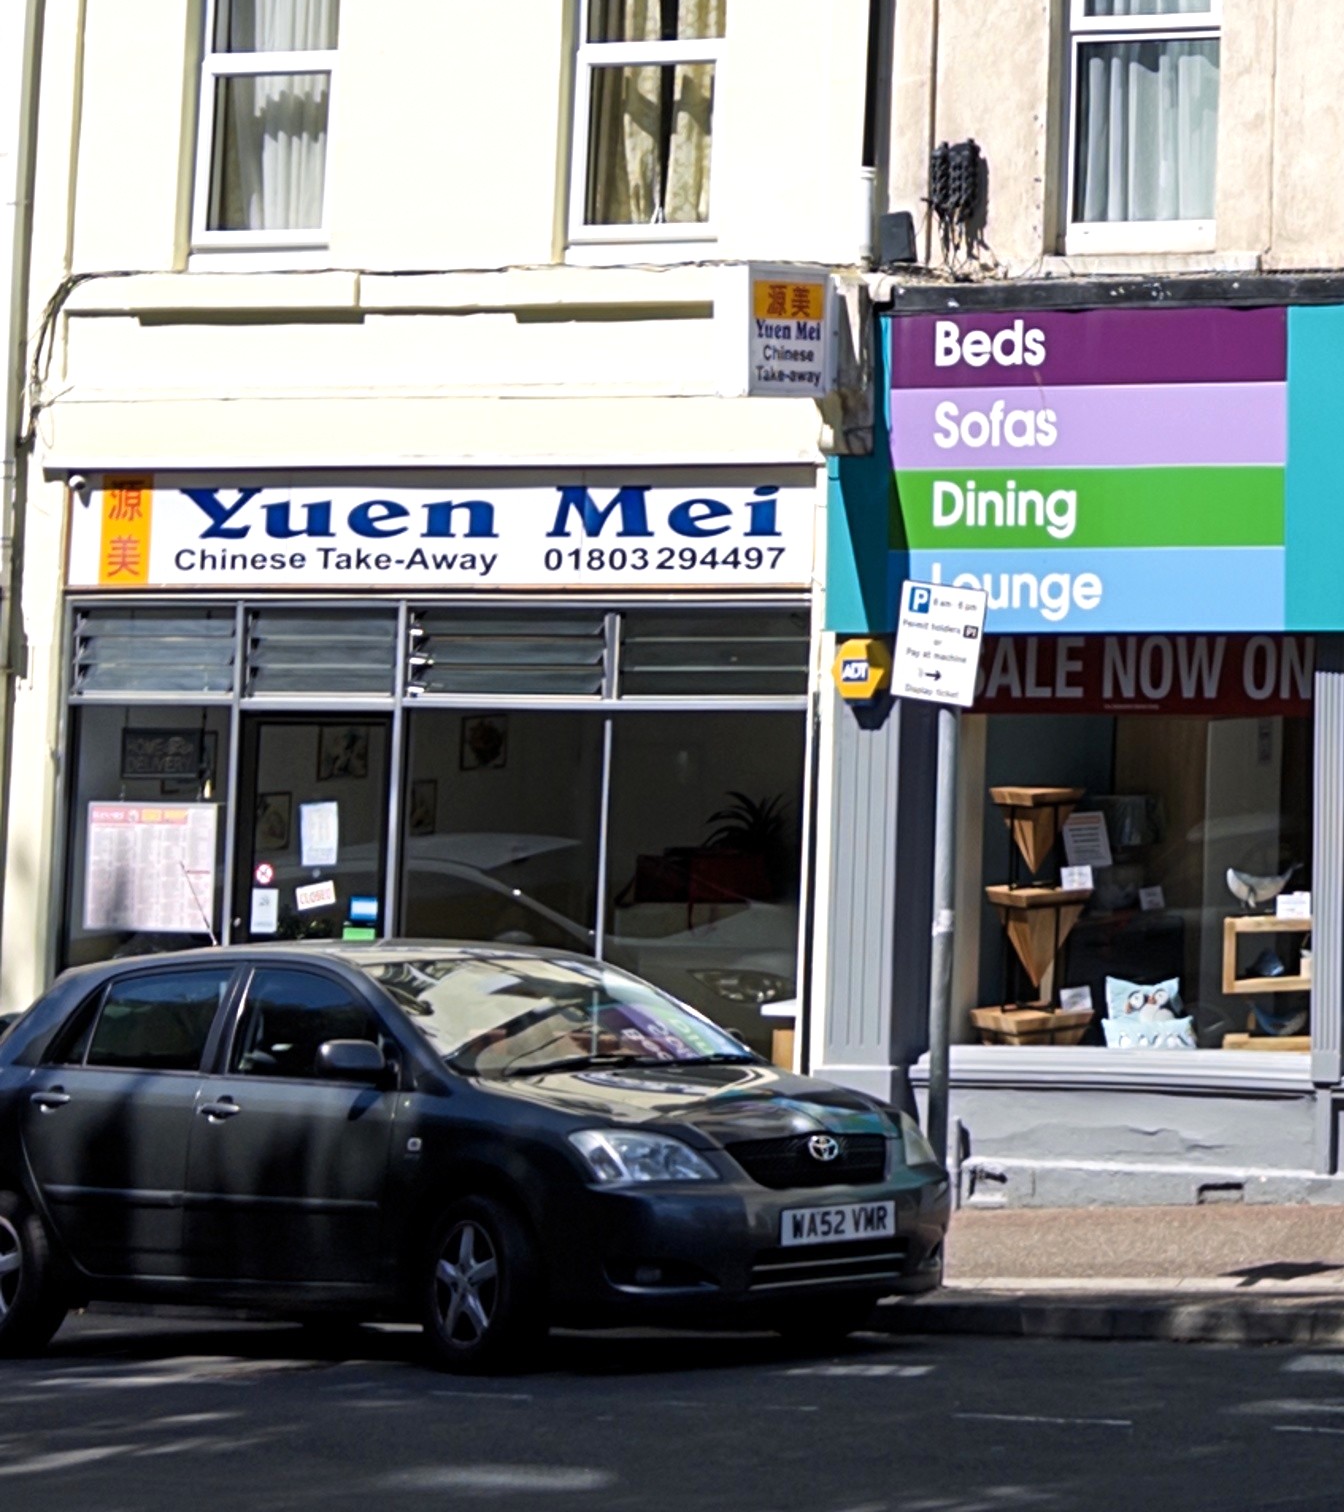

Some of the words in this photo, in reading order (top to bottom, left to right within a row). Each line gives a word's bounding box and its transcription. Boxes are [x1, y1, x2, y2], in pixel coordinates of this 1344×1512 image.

[756, 319, 791, 340] Yuen
[795, 321, 821, 341] Mei
[763, 345, 815, 362] Chinese
[934, 319, 1047, 367] Beds
[756, 366, 822, 387] Take-away
[933, 399, 1058, 448] Sofas
[179, 486, 500, 539] Yuen
[546, 485, 783, 537] Mei
[932, 480, 1077, 538] Dining
[174, 547, 307, 571] Chinese
[316, 547, 498, 576] Take-Away
[902, 618, 929, 630] Permit
[931, 623, 961, 635] holders
[905, 647, 920, 659] Pay
[923, 649, 931, 659] at
[933, 651, 967, 664] machine
[976, 635, 1086, 699] ALE
[1101, 635, 1228, 700] NOW
[1242, 635, 1316, 701] ON
[842, 661, 868, 679] ADT
[905, 683, 933, 697] Display
[936, 687, 959, 699] ticket
[792, 1209, 845, 1239] WA52
[852, 1205, 888, 1233] VMR
